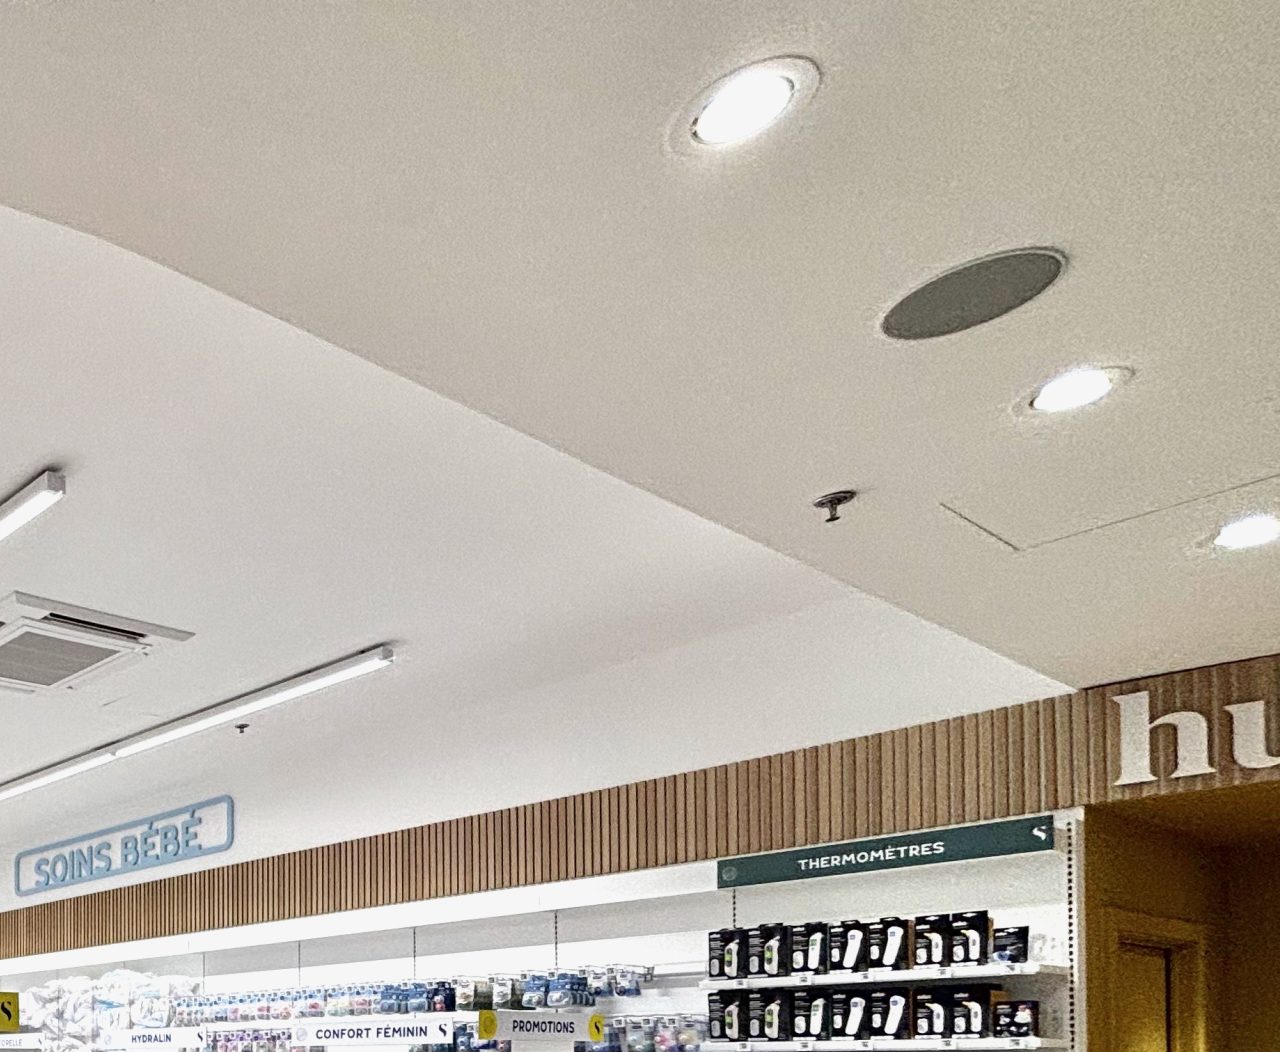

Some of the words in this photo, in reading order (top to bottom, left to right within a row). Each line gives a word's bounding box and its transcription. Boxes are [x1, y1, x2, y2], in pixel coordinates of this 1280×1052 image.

[1111, 690, 1280, 787] hu
[34, 841, 112, 887] SOINS
[120, 808, 202, 867] BÉBÉ
[797, 841, 945, 871] THERMOMÈTRES
[315, 1027, 372, 1040] CONFORT
[376, 1024, 428, 1038] FÉMININ
[512, 1019, 575, 1034] PROMOTIONS
[131, 1034, 172, 1043] HYDRALIN
